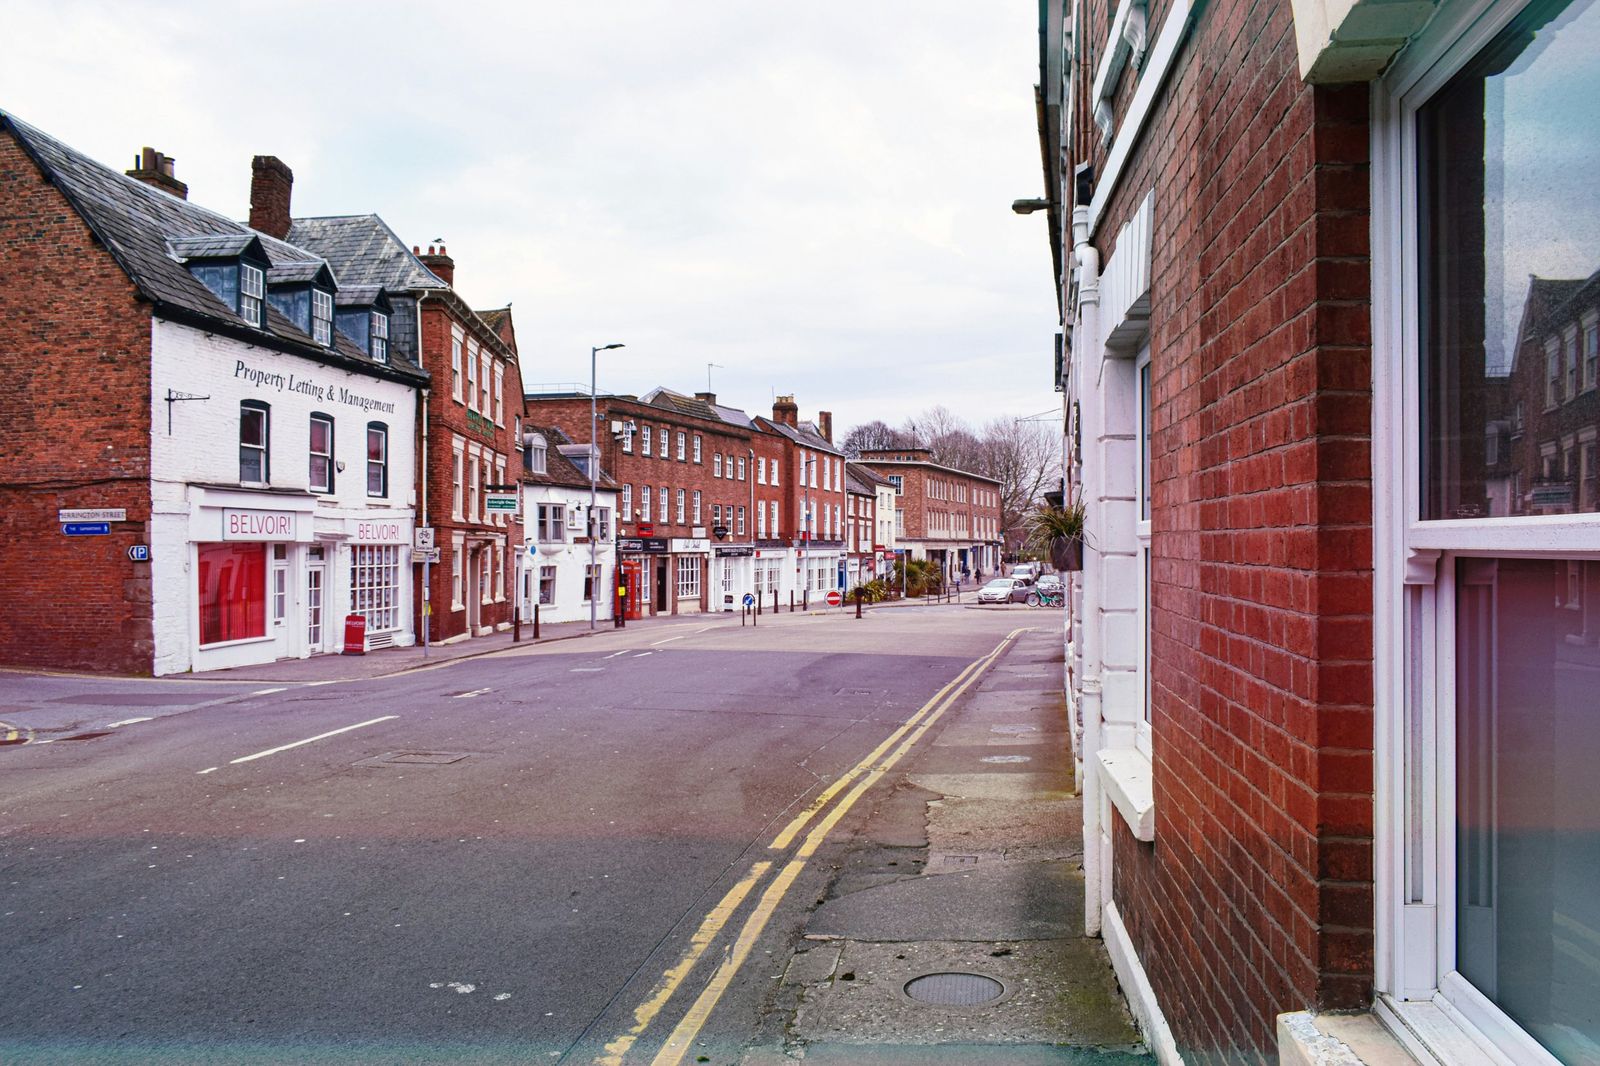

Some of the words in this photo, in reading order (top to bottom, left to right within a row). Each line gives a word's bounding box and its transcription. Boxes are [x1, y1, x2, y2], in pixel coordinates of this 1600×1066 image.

[234, 360, 286, 392] Property
[288, 374, 324, 403] Letting
[327, 385, 335, 402] &
[338, 387, 395, 414] Management
[230, 514, 291, 534] BELVOIR!
[358, 523, 399, 540] BELVOIR!
